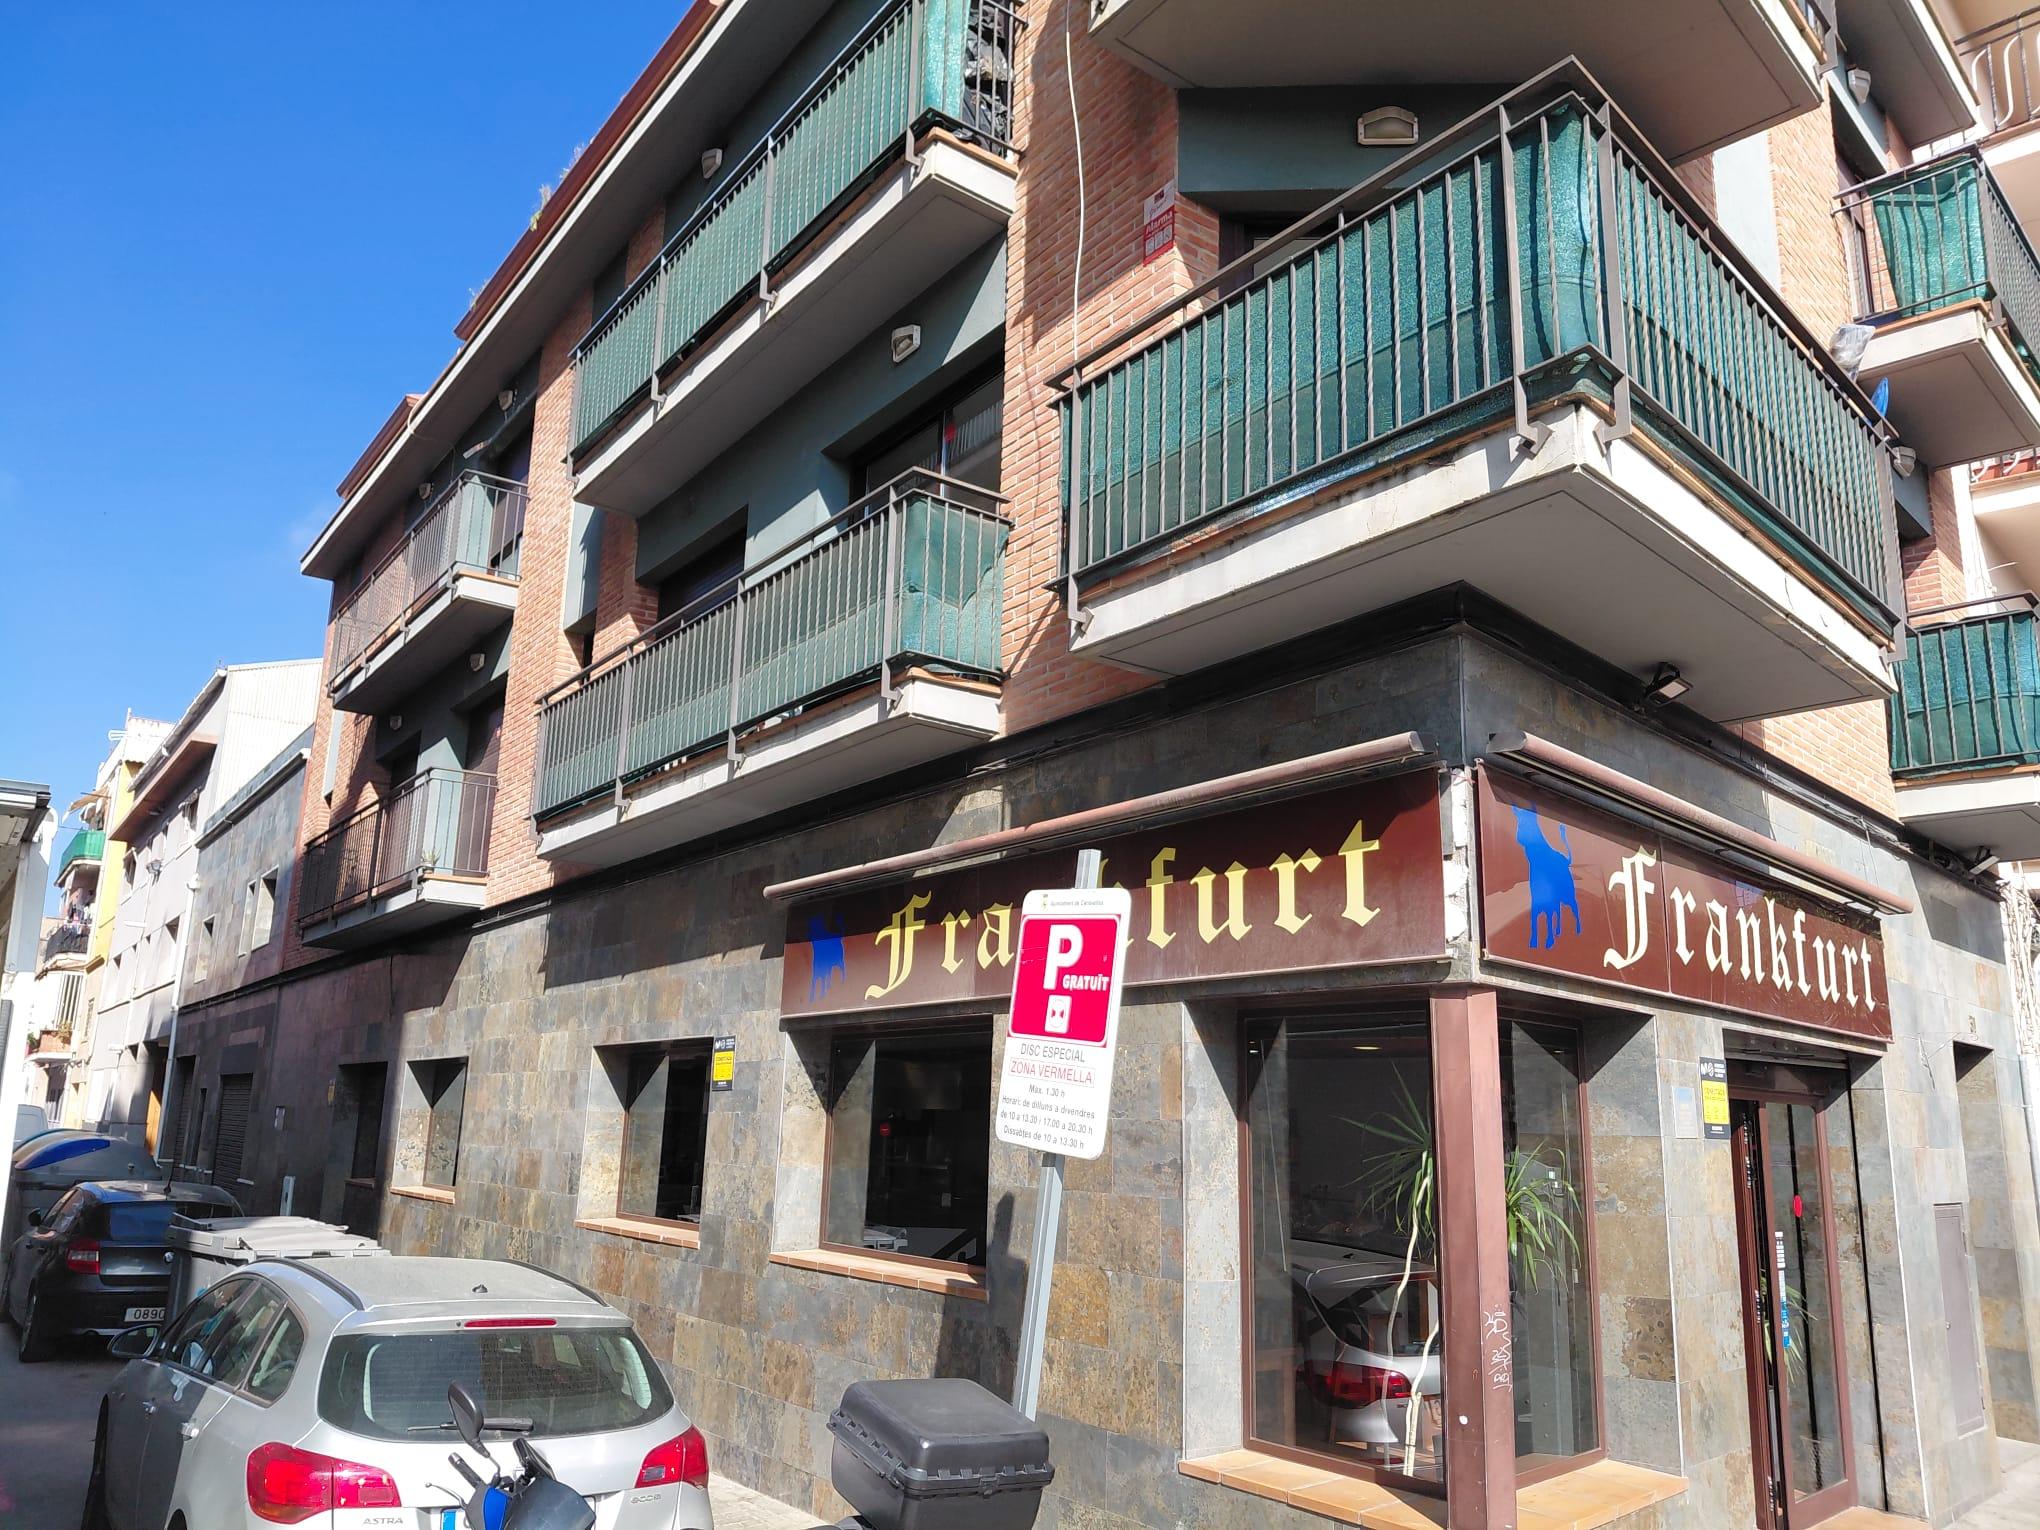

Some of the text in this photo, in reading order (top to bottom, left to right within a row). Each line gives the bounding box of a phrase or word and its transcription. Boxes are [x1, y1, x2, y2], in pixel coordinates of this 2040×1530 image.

[1145, 211, 1172, 236] Alarma
[865, 819, 1382, 1000] Frafurt
[1603, 845, 1877, 1012] Frankfurt
[1043, 924, 1084, 990] P
[1063, 974, 1110, 991] GRATUÏT
[1021, 1043, 1085, 1062] DISC ESPECIAL
[1010, 1060, 1092, 1084] ZONA VERMELLA
[1000, 1109, 1008, 1119] de
[1009, 1111, 1016, 1121] 10
[1022, 1114, 1038, 1125] 13.30
[1043, 1118, 1061, 1129] 17.00
[1067, 1121, 1087, 1134] 20.30
[1023, 1098, 1030, 1108] de
[1031, 1100, 1053, 1112] dilluns
[1060, 1105, 1095, 1120] divendres
[1003, 1124, 1032, 1139] Dissabtes
[1033, 1131, 1042, 1141] de
[1044, 1134, 1052, 1143] 10
[1060, 1136, 1078, 1149] 13.30
[363, 1517, 403, 1525] ASTRA
